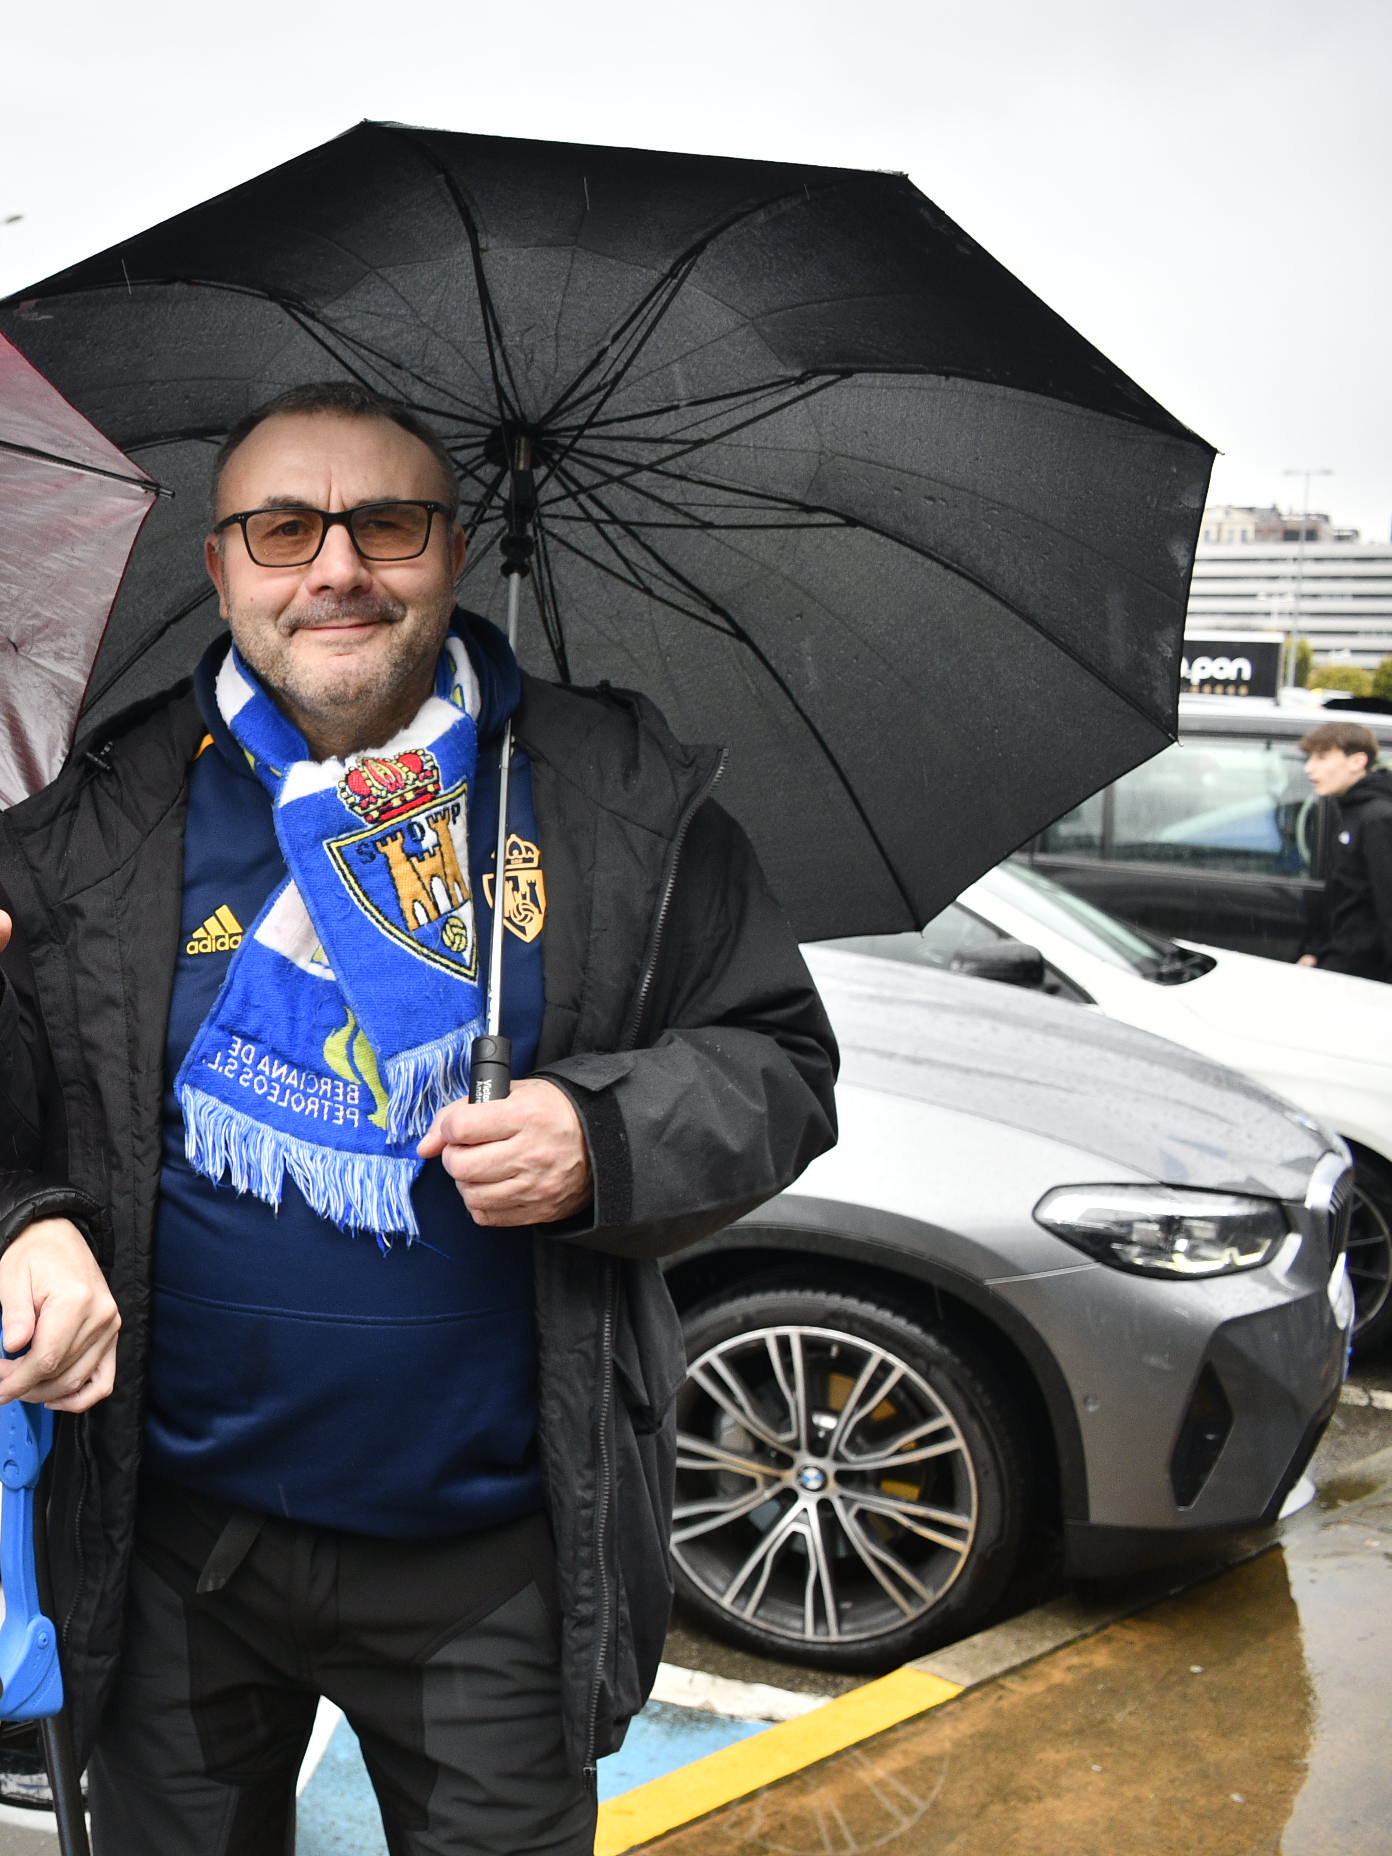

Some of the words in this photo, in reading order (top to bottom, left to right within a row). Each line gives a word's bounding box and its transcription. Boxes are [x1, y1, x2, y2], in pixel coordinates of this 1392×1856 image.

[356, 841, 376, 865] S
[451, 802, 461, 825] P
[186, 934, 243, 955] adida
